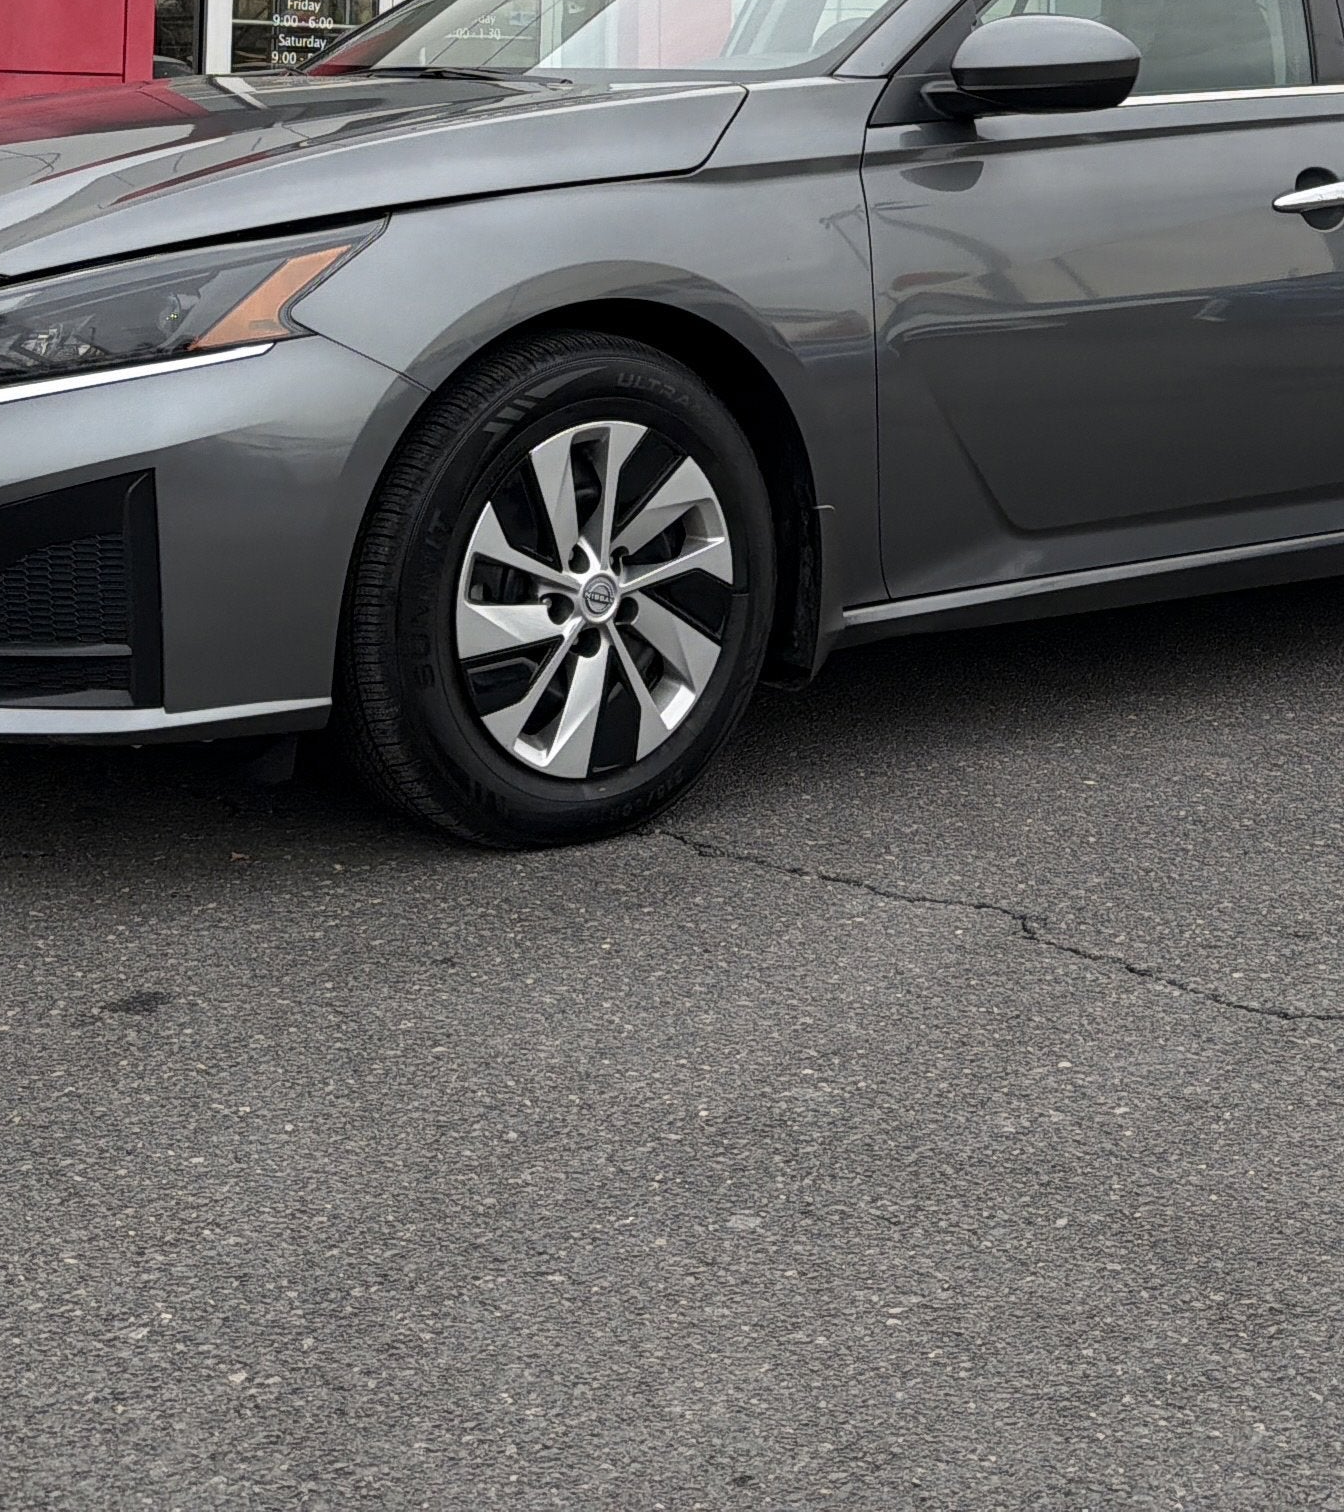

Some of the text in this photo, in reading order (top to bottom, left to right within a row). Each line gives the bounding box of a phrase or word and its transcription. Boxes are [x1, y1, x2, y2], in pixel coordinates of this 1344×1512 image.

[272, 14, 299, 28] 9:00
[308, 16, 334, 30] 6:00
[278, 34, 327, 49] Saturday
